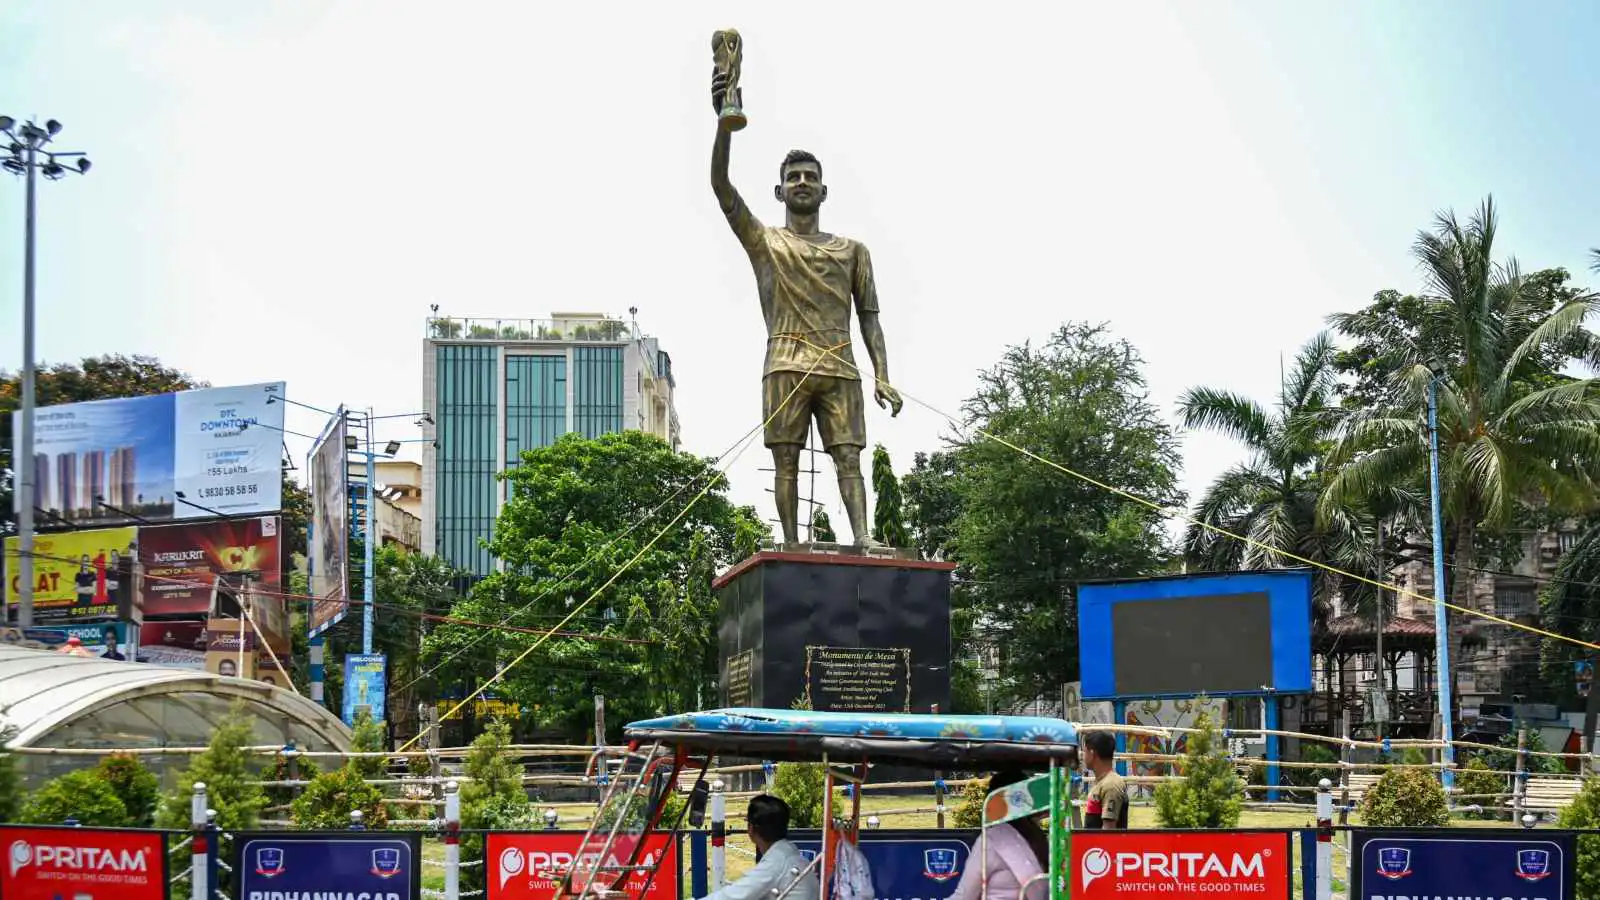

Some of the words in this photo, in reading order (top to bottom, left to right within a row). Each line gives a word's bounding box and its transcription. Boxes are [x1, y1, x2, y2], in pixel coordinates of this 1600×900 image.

[201, 417, 258, 431] DOWNTOWN
[12, 572, 60, 594] CAT
[67, 627, 102, 639] SCHOOL
[864, 651, 874, 660] de
[35, 845, 147, 872] PRITAM
[1116, 852, 1265, 878] PRITAM
[528, 880, 557, 890] SWIT
[630, 881, 657, 891] TIMS
[1116, 882, 1156, 892] SWITCH
[1158, 882, 1174, 892] ON
[1177, 882, 1197, 892] THE
[1199, 882, 1231, 892] GOOD
[1233, 882, 1266, 893] TIMES
